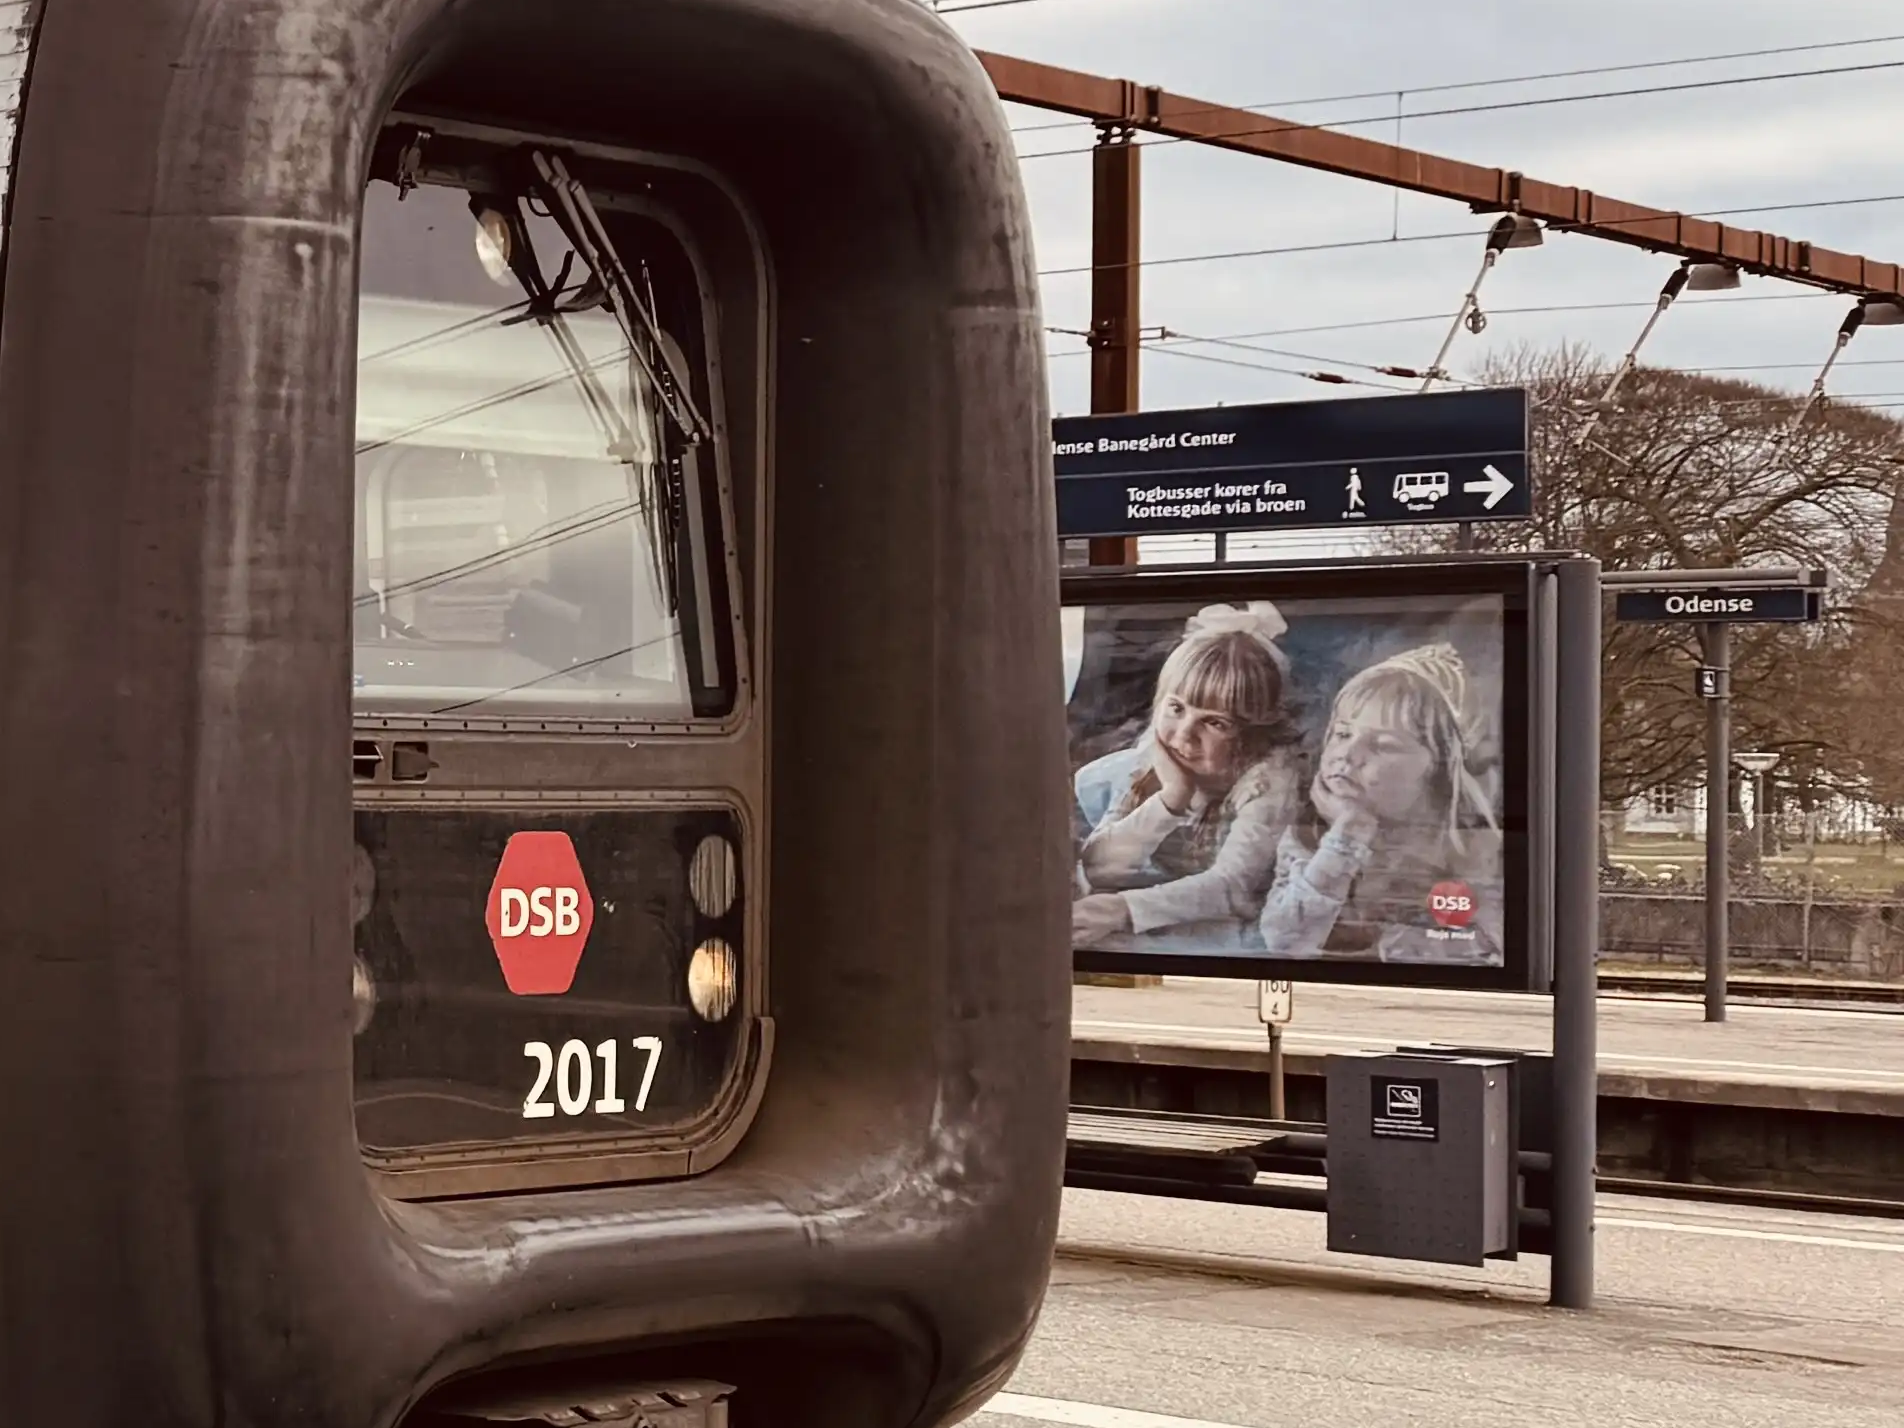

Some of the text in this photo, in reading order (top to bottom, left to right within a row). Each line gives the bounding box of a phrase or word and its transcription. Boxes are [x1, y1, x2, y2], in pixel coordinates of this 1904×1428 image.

[1098, 434, 1175, 453] Banegård
[1180, 432, 1236, 447] Center
[1127, 480, 1287, 503] Togbusser kører fra
[1127, 499, 1306, 519] Kottesgade via broen
[1665, 595, 1754, 614] Odense
[500, 887, 581, 937] DSB
[1433, 895, 1471, 911] DSB
[523, 1036, 662, 1118] 2017
